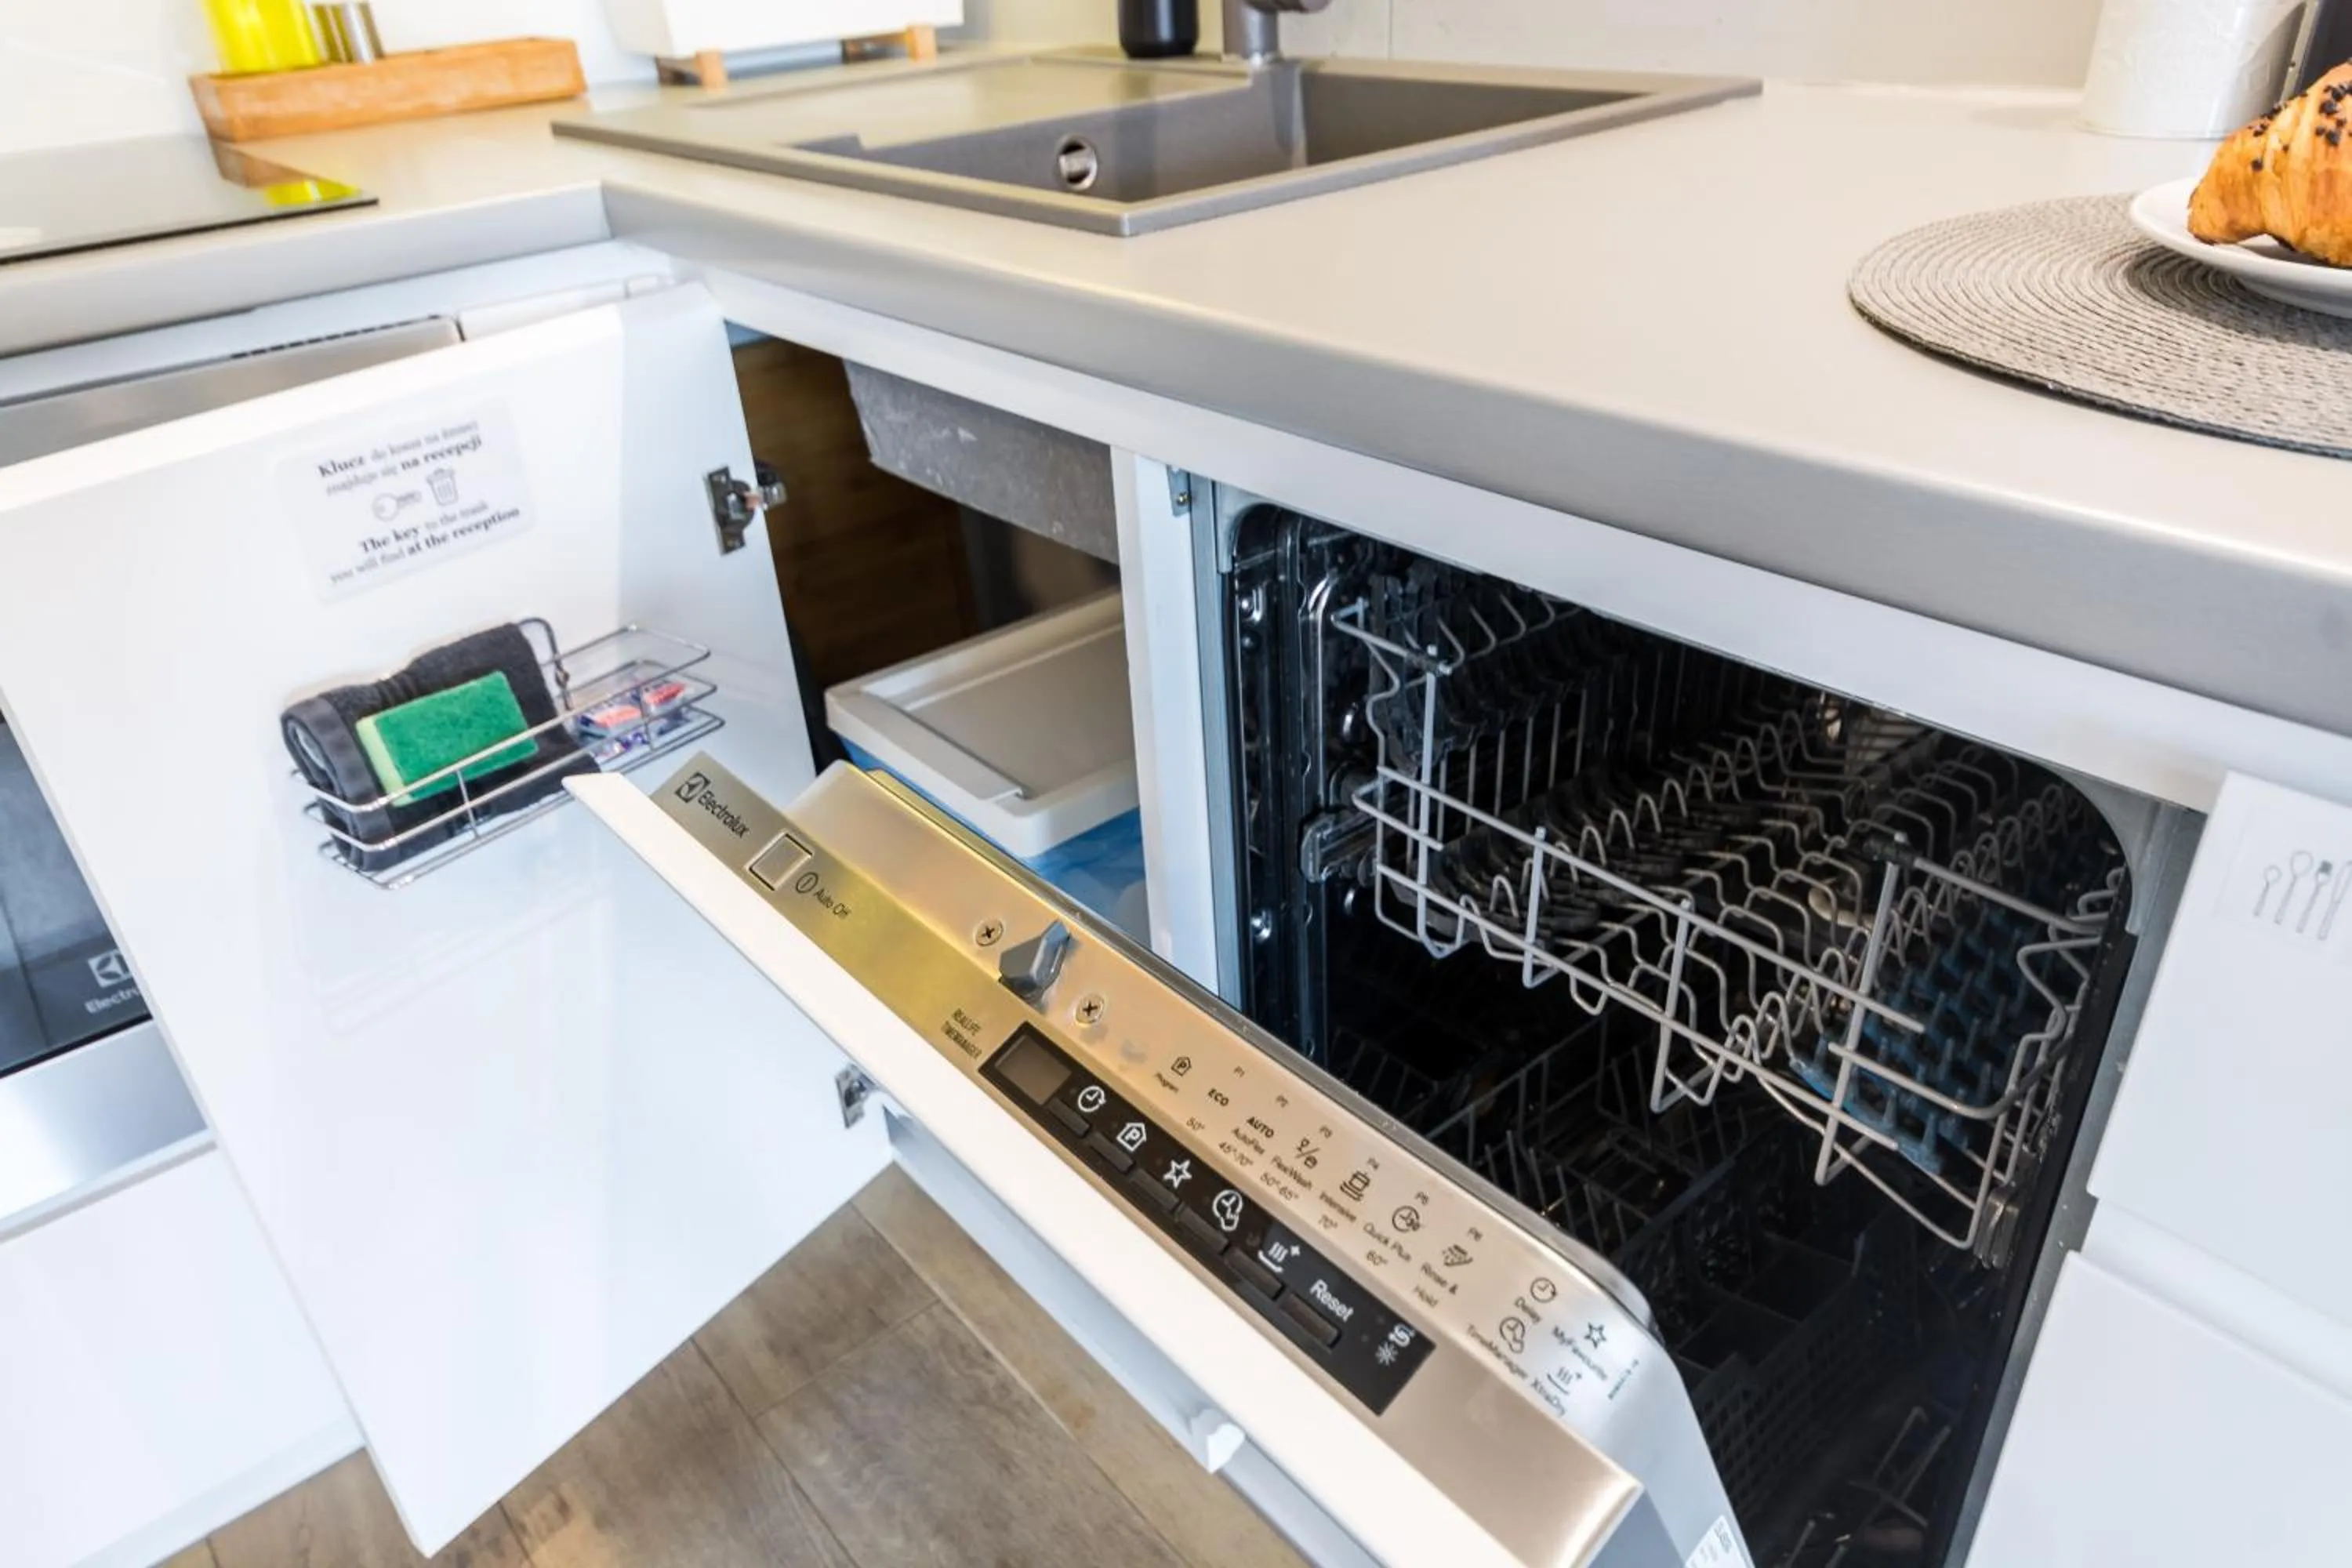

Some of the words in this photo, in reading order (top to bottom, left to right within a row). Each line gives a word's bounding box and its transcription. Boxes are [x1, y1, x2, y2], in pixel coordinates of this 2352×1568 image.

[318, 454, 365, 477] Klucz
[401, 459, 420, 471] na
[424, 434, 481, 463] recepcji
[360, 535, 390, 554] The
[392, 526, 419, 544] key
[408, 541, 422, 556] at
[426, 531, 449, 548] the
[452, 506, 521, 539] reception
[698, 789, 750, 839] Electrolux
[814, 888, 833, 909] Auto
[1207, 1088, 1229, 1107] ECO
[1232, 1127, 1265, 1155] AutoFlex
[1247, 1116, 1275, 1138] AUTO
[1363, 1221, 1390, 1247] Quick
[1309, 1279, 1354, 1323] Reset
